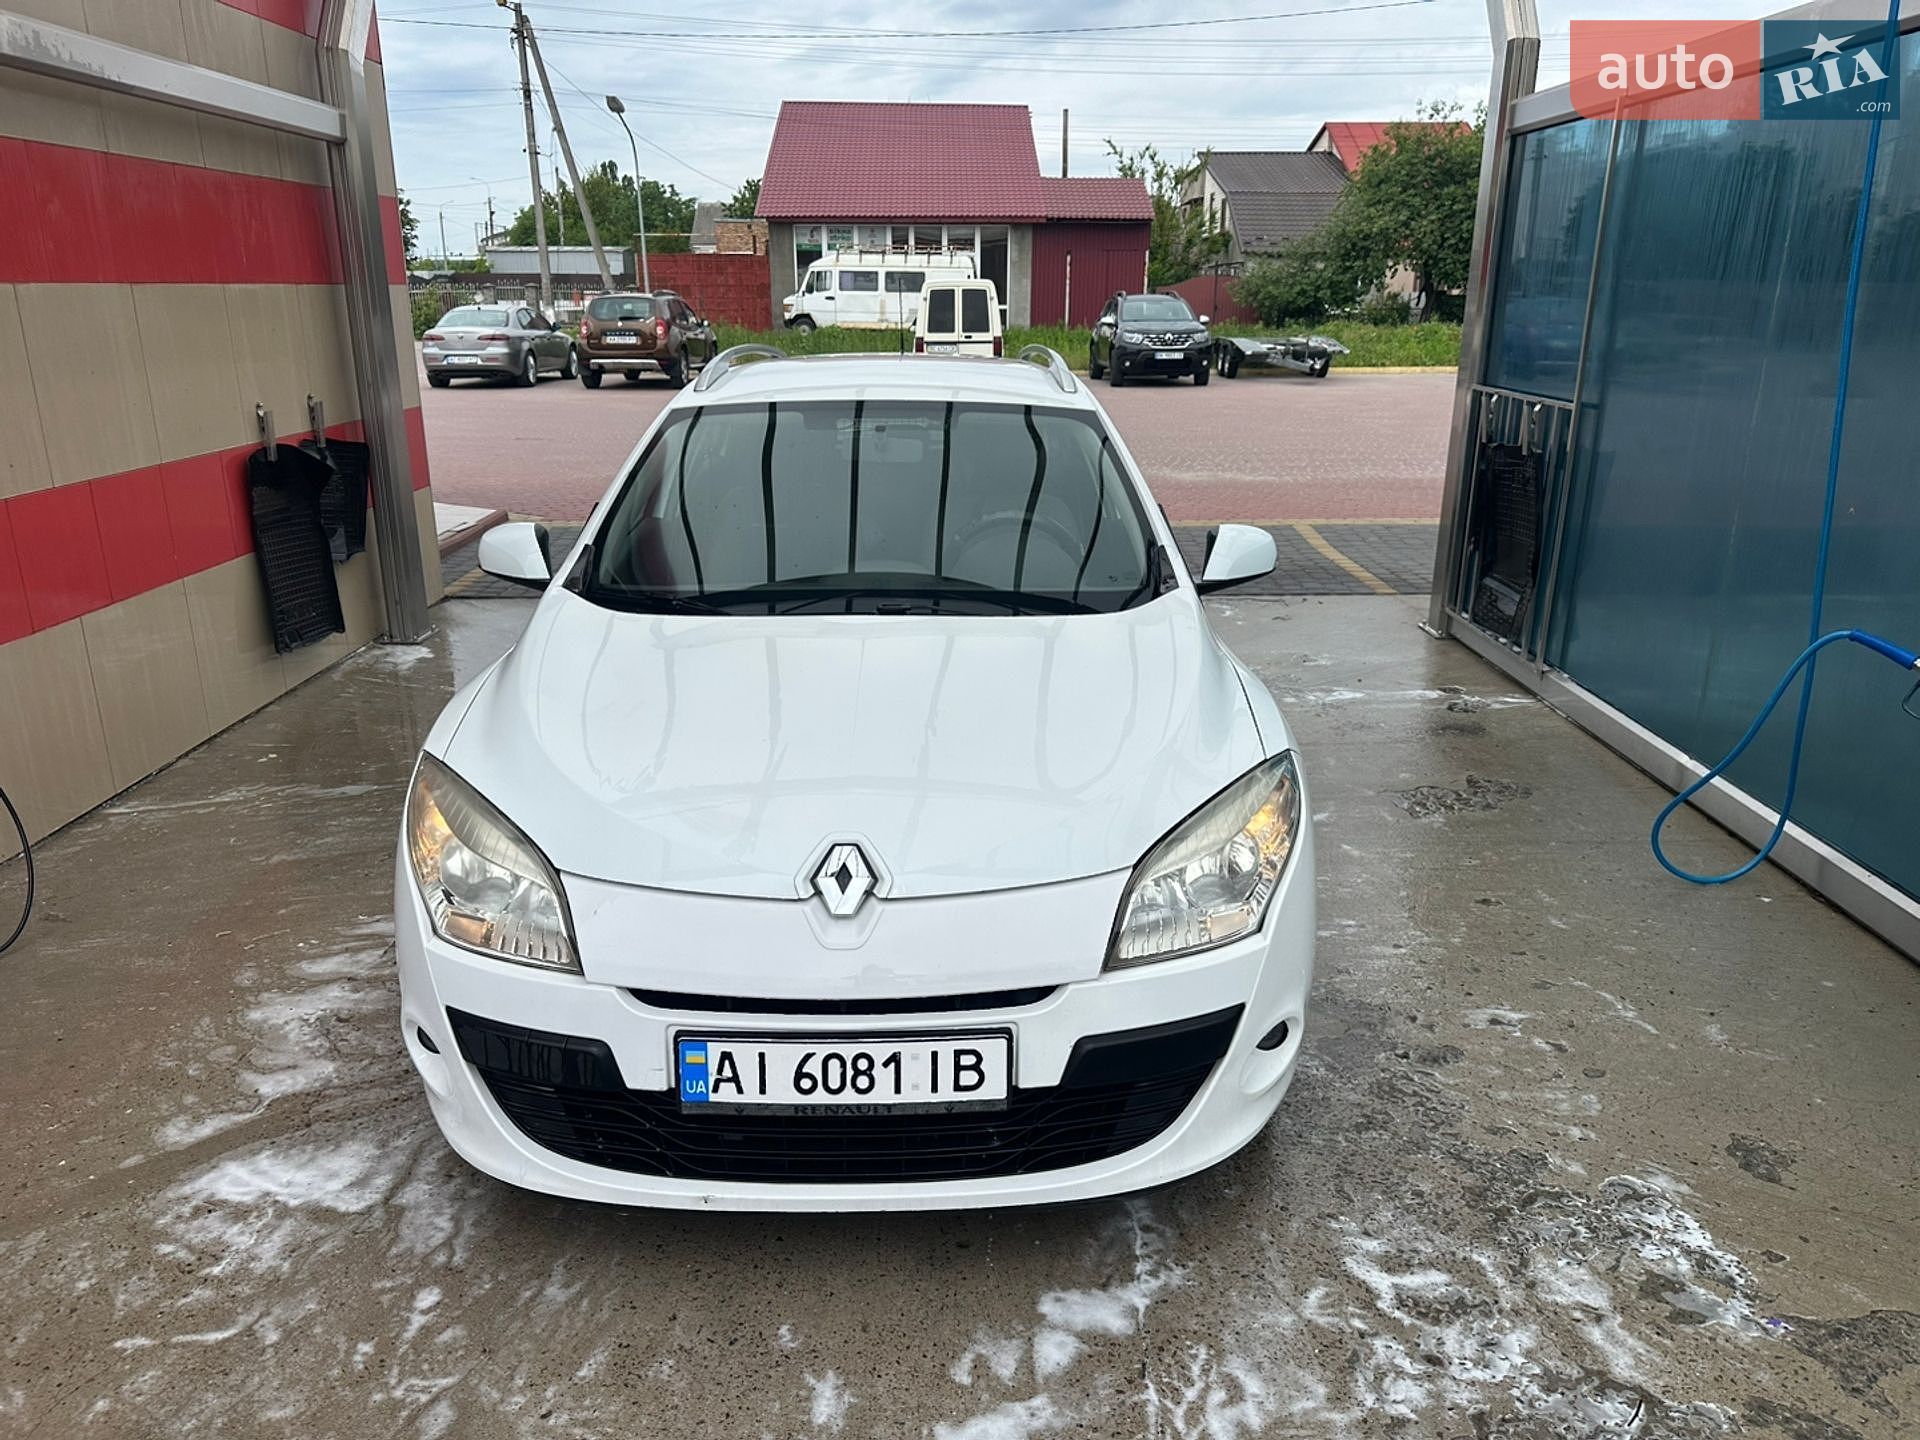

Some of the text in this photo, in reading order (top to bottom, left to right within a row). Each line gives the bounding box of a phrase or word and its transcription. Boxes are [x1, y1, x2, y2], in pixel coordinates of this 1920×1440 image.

[686, 1080, 707, 1093] UA
[711, 1048, 986, 1095] AI 6081 IB
